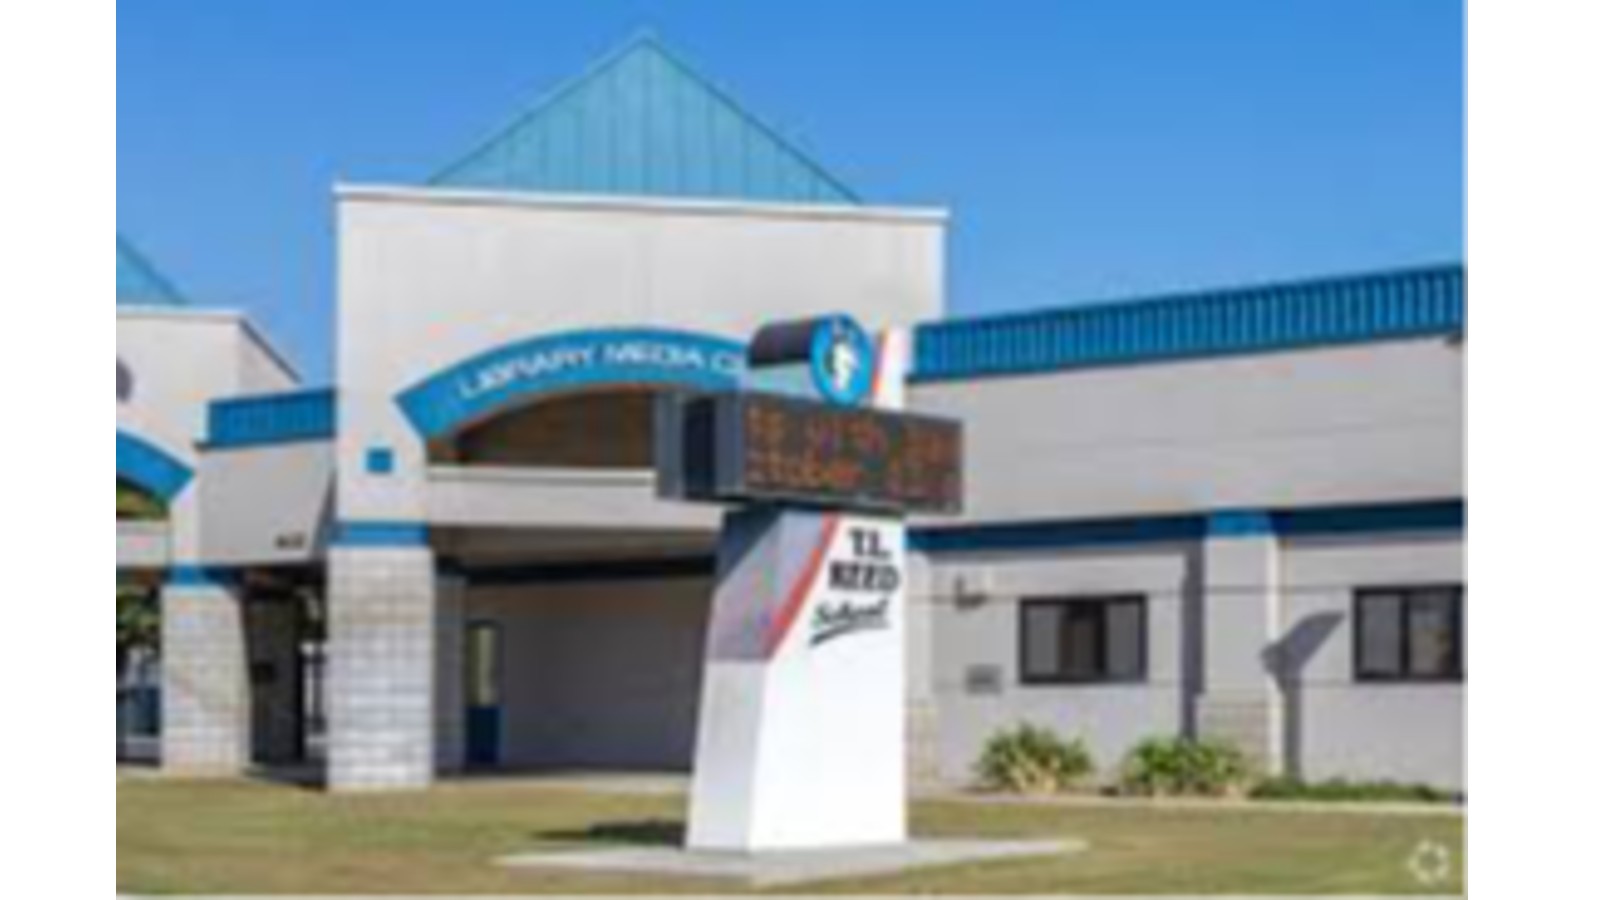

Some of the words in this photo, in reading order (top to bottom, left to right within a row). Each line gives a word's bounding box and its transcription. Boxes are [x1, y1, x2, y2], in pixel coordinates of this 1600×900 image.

[457, 346, 595, 400] LIBRARY
[604, 342, 706, 370] MEDIA
[829, 560, 901, 593] REED
[811, 598, 891, 631] School
